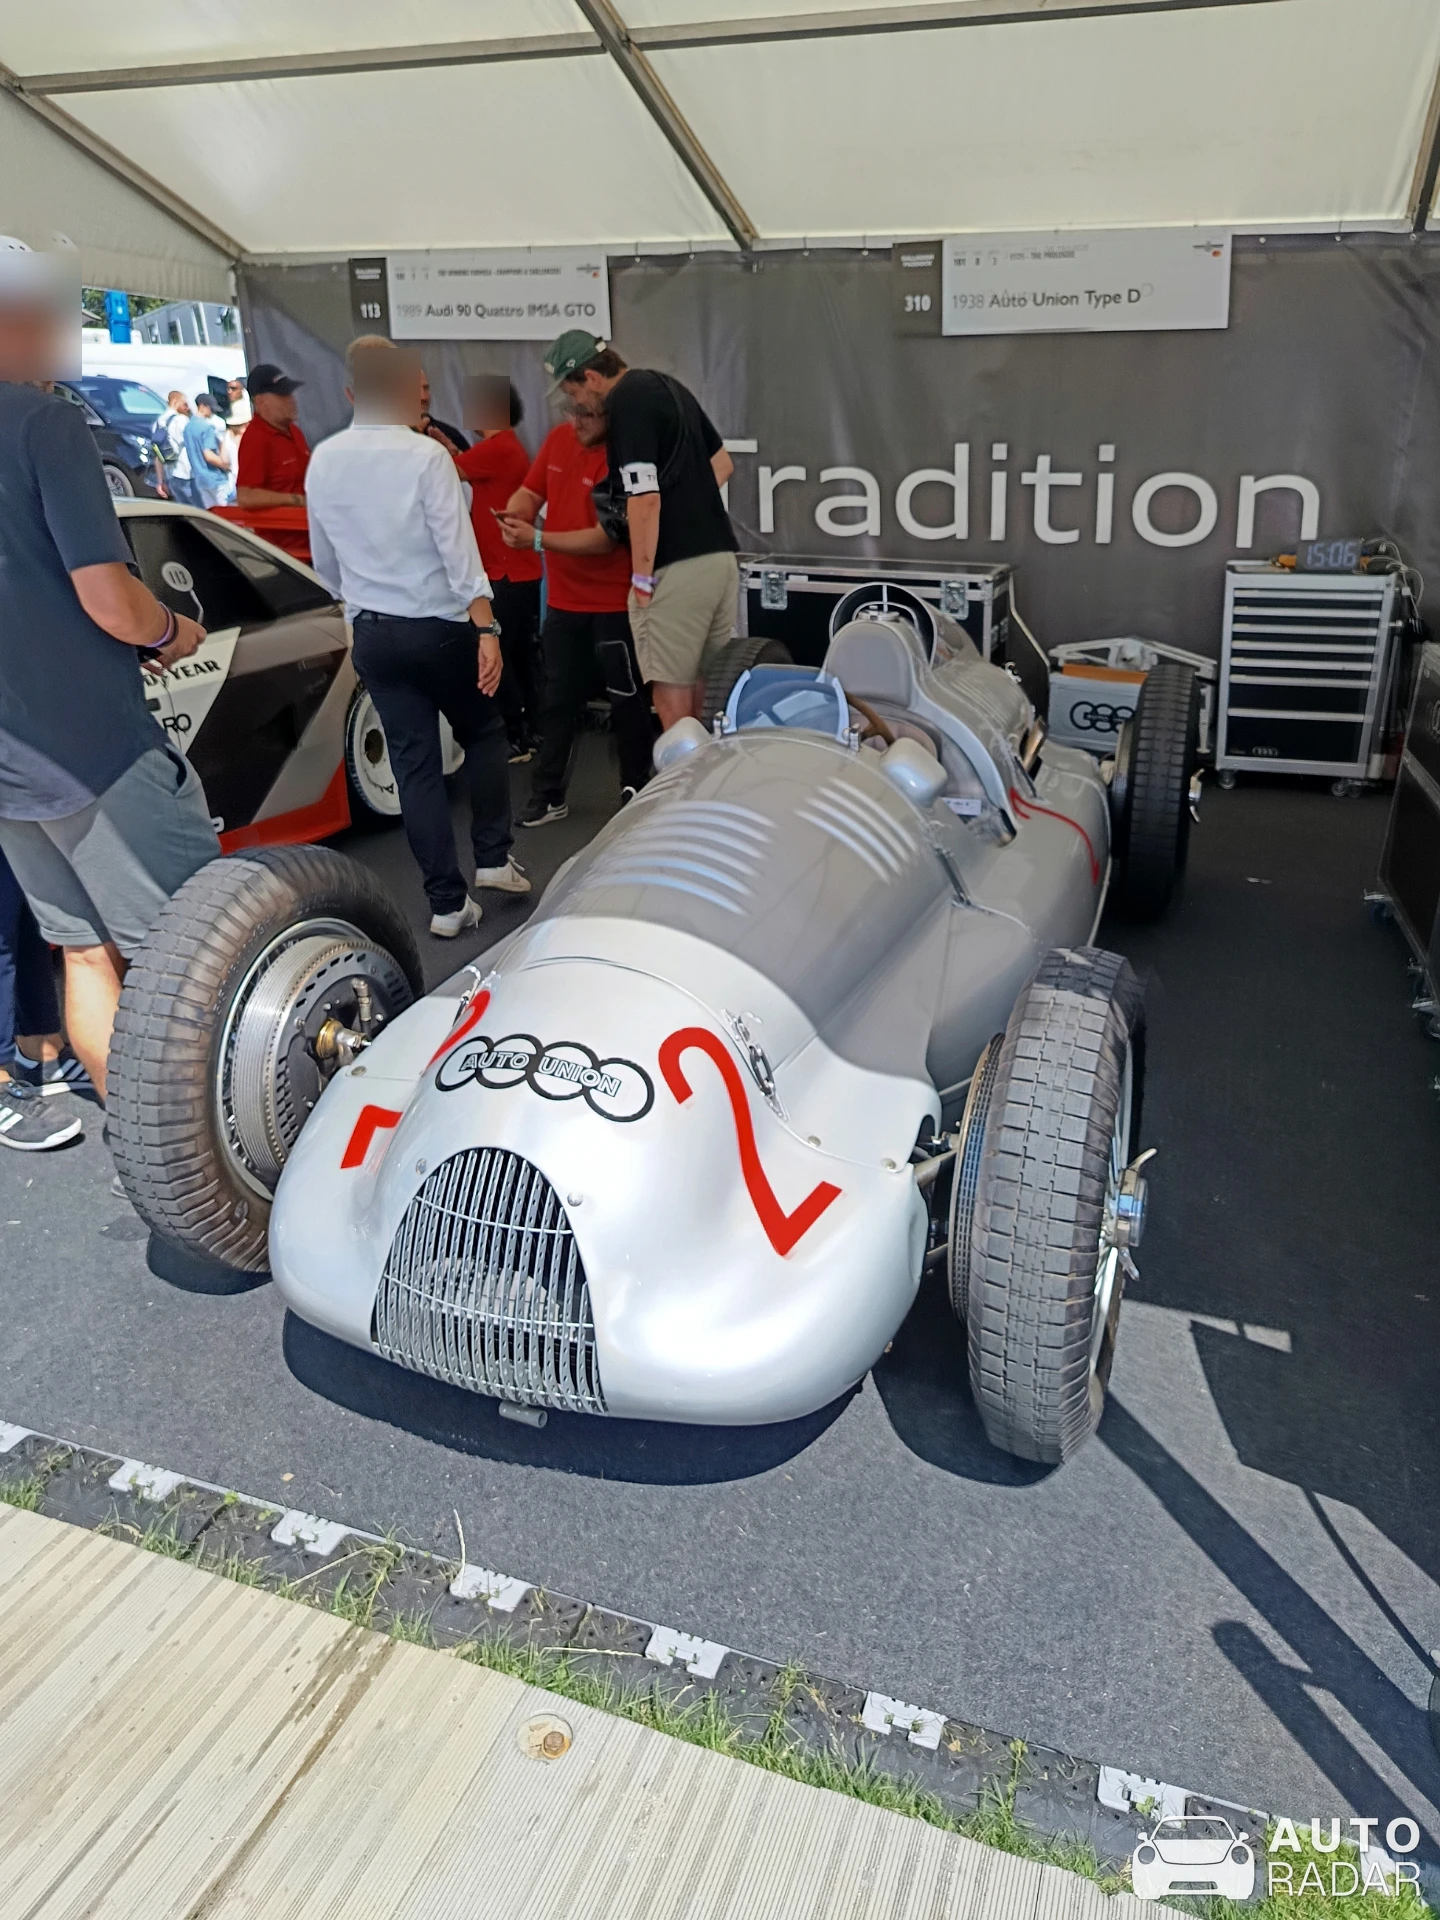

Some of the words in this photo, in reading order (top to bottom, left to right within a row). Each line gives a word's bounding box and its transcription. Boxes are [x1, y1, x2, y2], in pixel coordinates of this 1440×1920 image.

[904, 294, 932, 312] 310
[988, 290, 1028, 308] Auto
[1031, 291, 1080, 308] Union
[1084, 289, 1122, 307] Type
[1126, 288, 1142, 304] D
[359, 302, 382, 319] 113
[426, 303, 454, 318] Audi
[457, 304, 472, 317] 90
[474, 303, 524, 319] Quattro
[527, 303, 561, 317] IMSA
[564, 302, 597, 317] GTO
[1306, 540, 1358, 568] 15:06
[168, 570, 189, 586] 113
[459, 1051, 531, 1072] AUTO
[537, 1056, 622, 1097] UNION
[657, 1026, 843, 1257] 2
